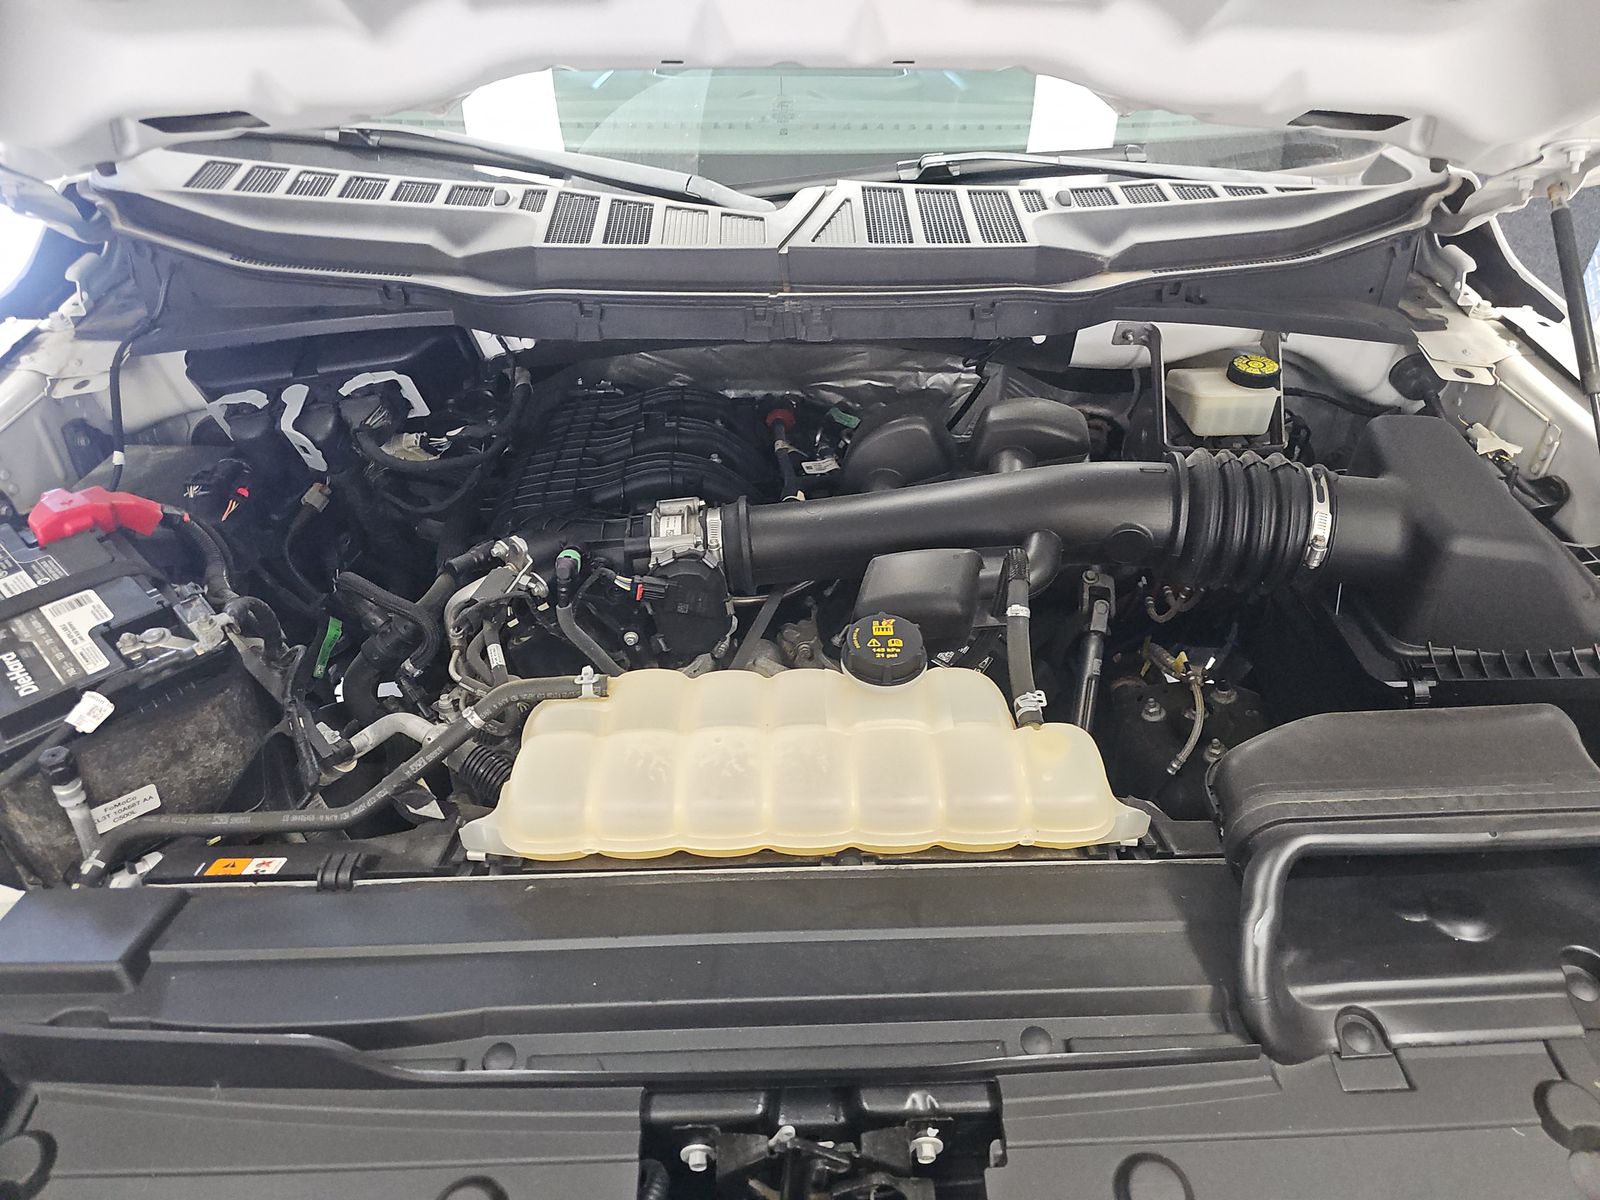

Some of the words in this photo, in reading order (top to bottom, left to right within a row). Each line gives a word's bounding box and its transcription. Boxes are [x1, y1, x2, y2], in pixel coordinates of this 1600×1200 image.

[0, 651, 40, 698] DieHard
[103, 796, 137, 813] FoMoCo
[143, 795, 154, 803] AA
